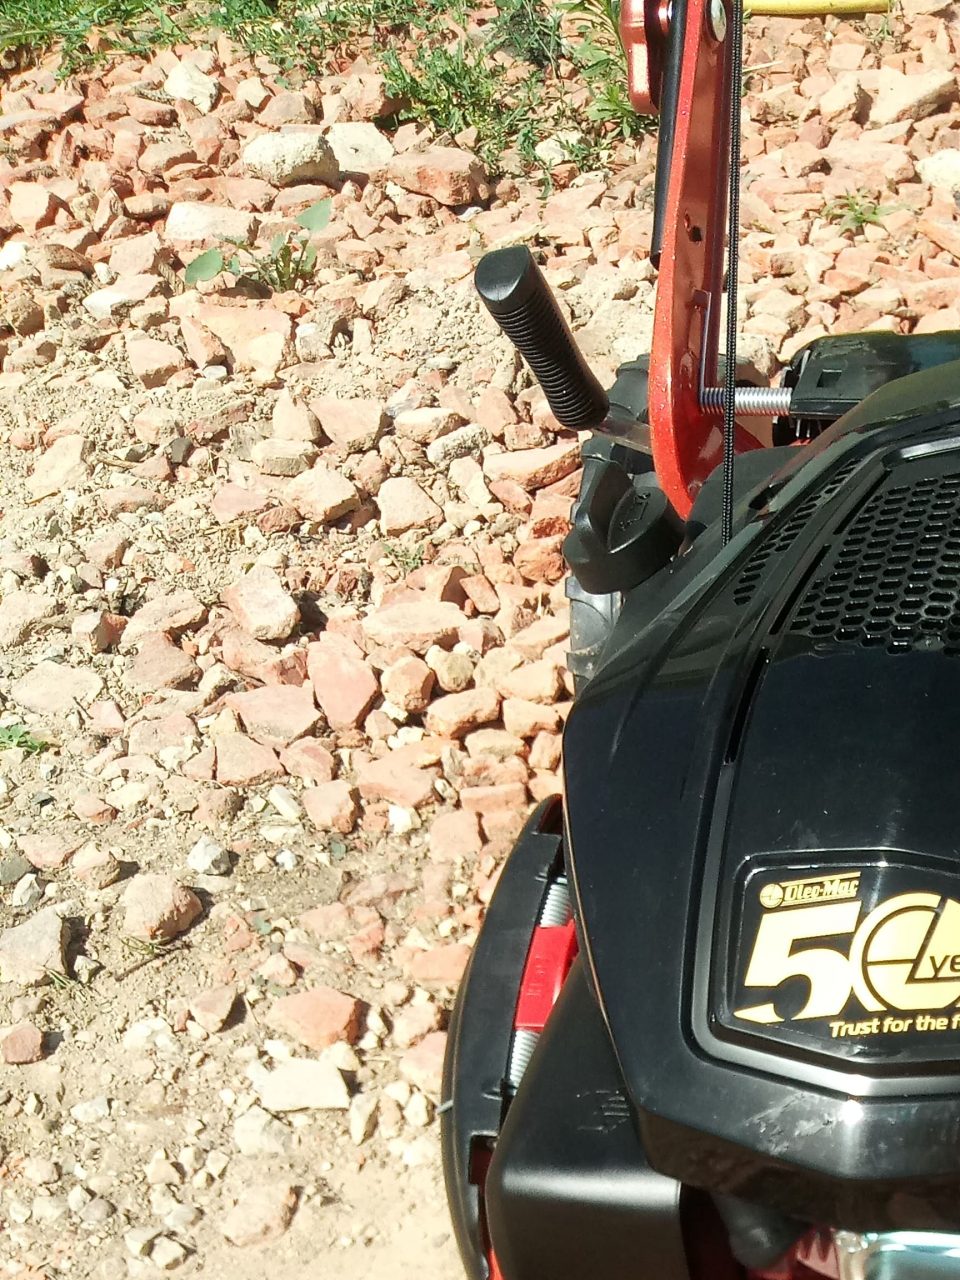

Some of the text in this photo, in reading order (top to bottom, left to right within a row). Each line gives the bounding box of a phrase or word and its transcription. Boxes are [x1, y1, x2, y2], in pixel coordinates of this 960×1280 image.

[784, 879, 860, 901] Oleo-Mac
[829, 1017, 881, 1038] Trust
[882, 1015, 914, 1034] for
[915, 1014, 949, 1031] the
